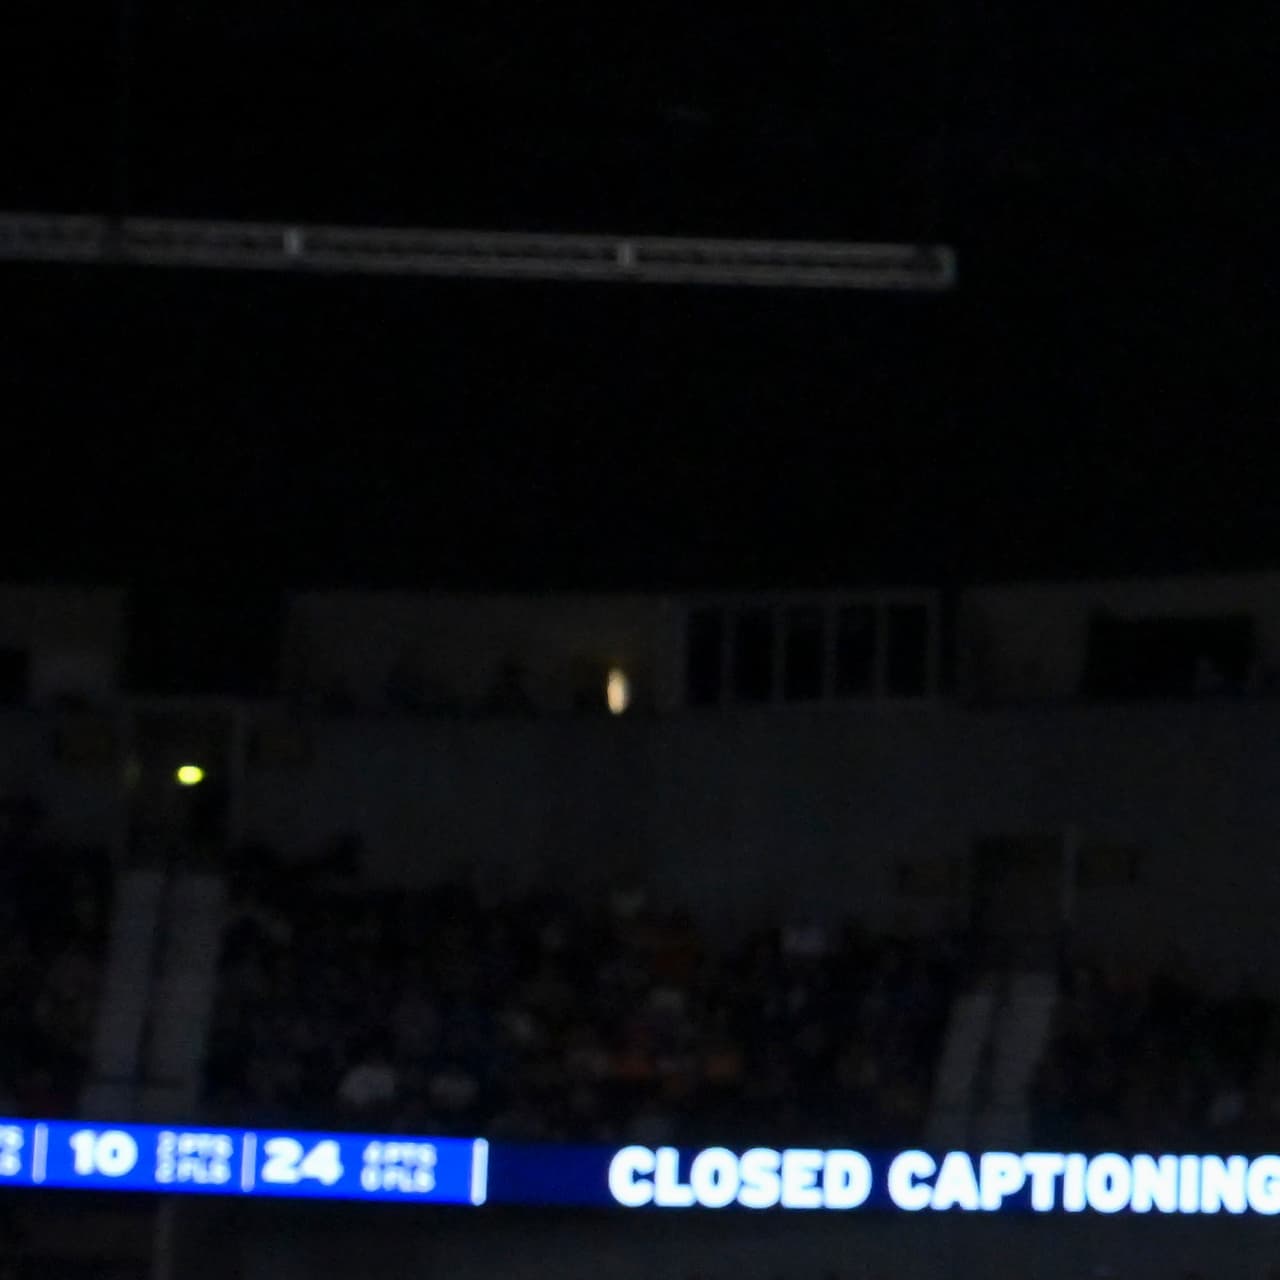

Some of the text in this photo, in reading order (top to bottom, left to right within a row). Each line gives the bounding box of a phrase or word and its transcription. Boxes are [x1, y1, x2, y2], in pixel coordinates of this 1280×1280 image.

[69, 1129, 139, 1178] 10
[261, 1136, 345, 1186] 24
[608, 1145, 872, 1209] CLOSED
